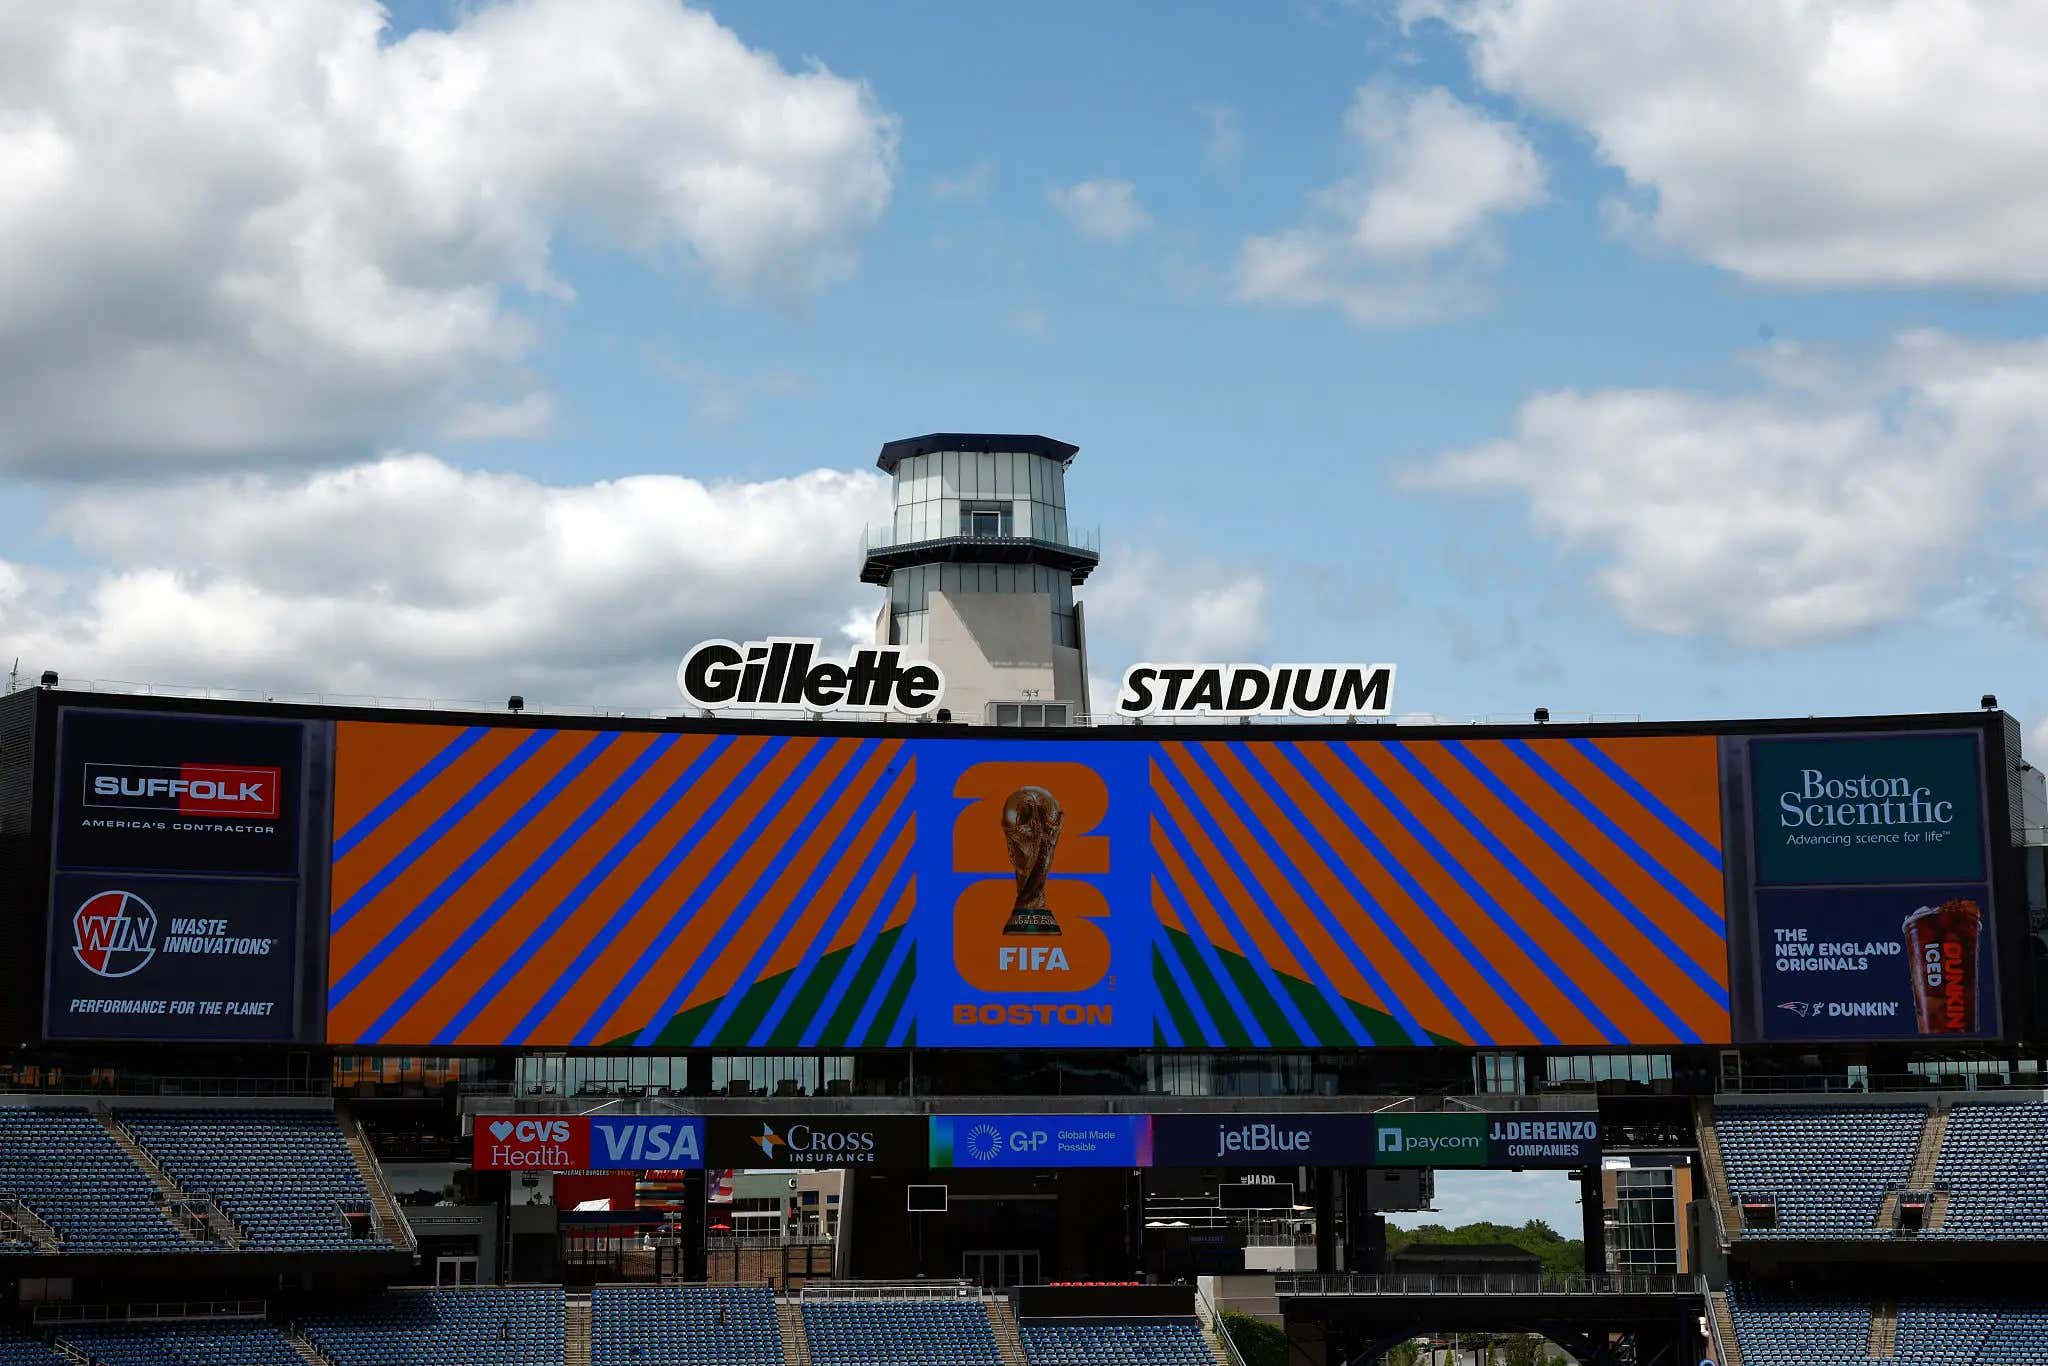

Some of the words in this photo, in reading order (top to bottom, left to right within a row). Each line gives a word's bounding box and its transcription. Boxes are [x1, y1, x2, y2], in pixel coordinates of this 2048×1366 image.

[683, 642, 940, 709] Gillette
[1121, 668, 1391, 711] STADIUM
[95, 776, 263, 802] SUFFOLK
[1800, 769, 1910, 800] Boston
[1780, 787, 1953, 827] Scientific
[81, 819, 166, 830] AMERICA'S
[173, 823, 274, 834] CONTRACTOR
[1787, 832, 1851, 846] Advancing
[1856, 832, 1899, 844] science
[1904, 831, 1920, 842] for
[171, 918, 228, 936] WASTE
[1774, 928, 1808, 942] THE
[1775, 943, 1814, 957] NEW
[1818, 942, 1901, 956] ENGLAND
[1000, 947, 1069, 971] FIFA
[1776, 957, 1868, 972] ORIGINALS
[1925, 943, 1942, 987] ICED
[70, 999, 166, 1015] PERFORMANCE
[169, 1000, 194, 1015] FOR
[200, 1001, 222, 1015] THE
[225, 1001, 274, 1016] PLANET
[953, 1004, 1112, 1025] BOSTON
[1829, 1002, 1899, 1017] DUNKIN'
[515, 1120, 570, 1143] CVS
[1058, 1130, 1087, 1140] Global
[1090, 1130, 1116, 1140] Made
[1217, 1123, 1311, 1157] jetBlue
[1489, 1121, 1597, 1141] J.DERENZO
[595, 1124, 700, 1161] VISA
[1058, 1142, 1097, 1152] Possible
[1508, 1144, 1579, 1157] COMPANIES
[789, 1153, 874, 1163] INSURANCE
